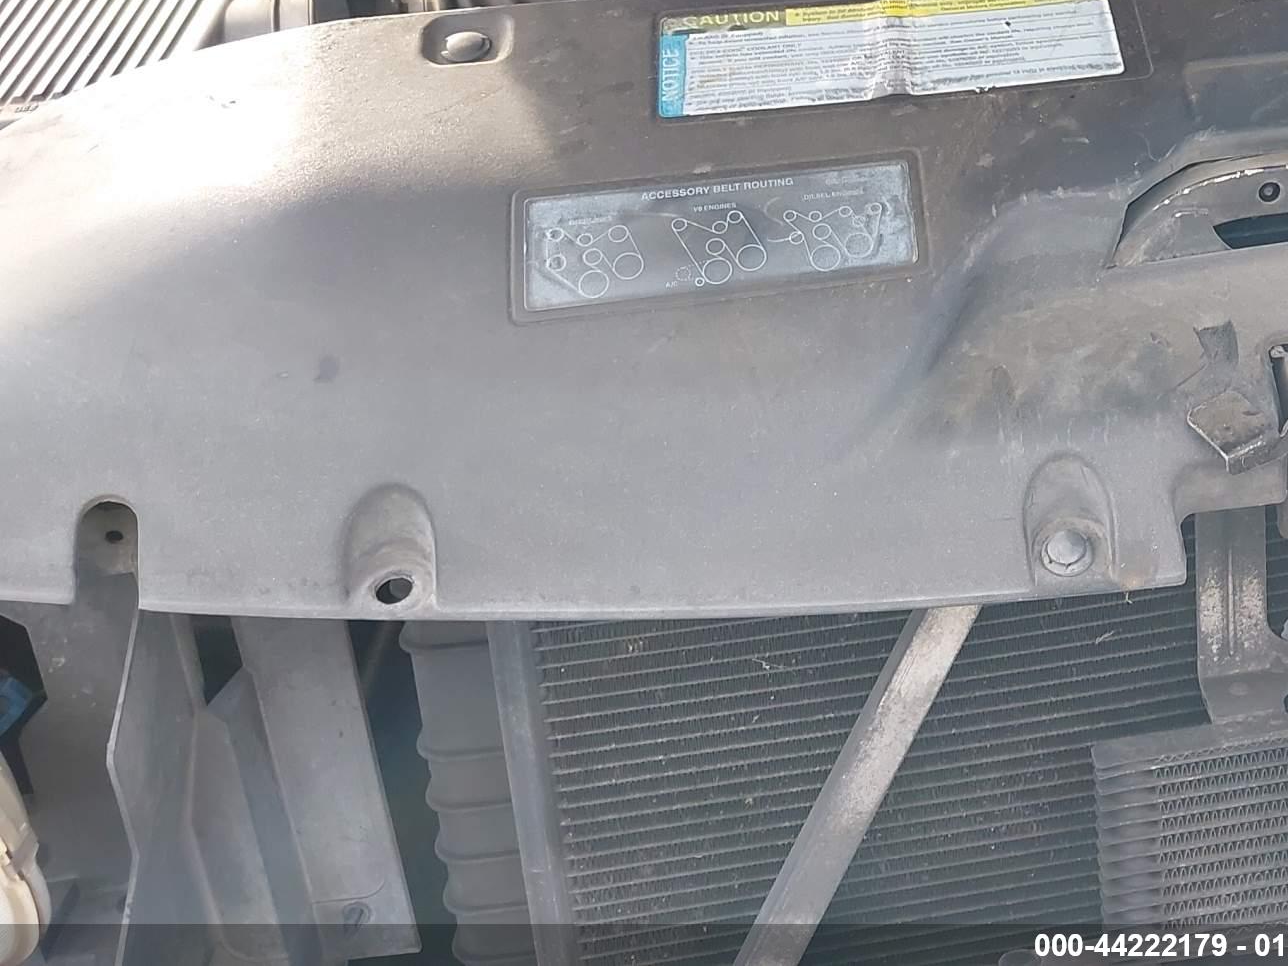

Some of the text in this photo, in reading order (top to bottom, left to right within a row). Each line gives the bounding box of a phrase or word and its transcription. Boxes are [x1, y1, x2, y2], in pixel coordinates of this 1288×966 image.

[683, 10, 780, 27] CAUTION
[662, 48, 681, 102] NOTICE
[641, 177, 794, 201] ACCESSORY BELT ROUTING
[705, 202, 737, 212] ENGINES
